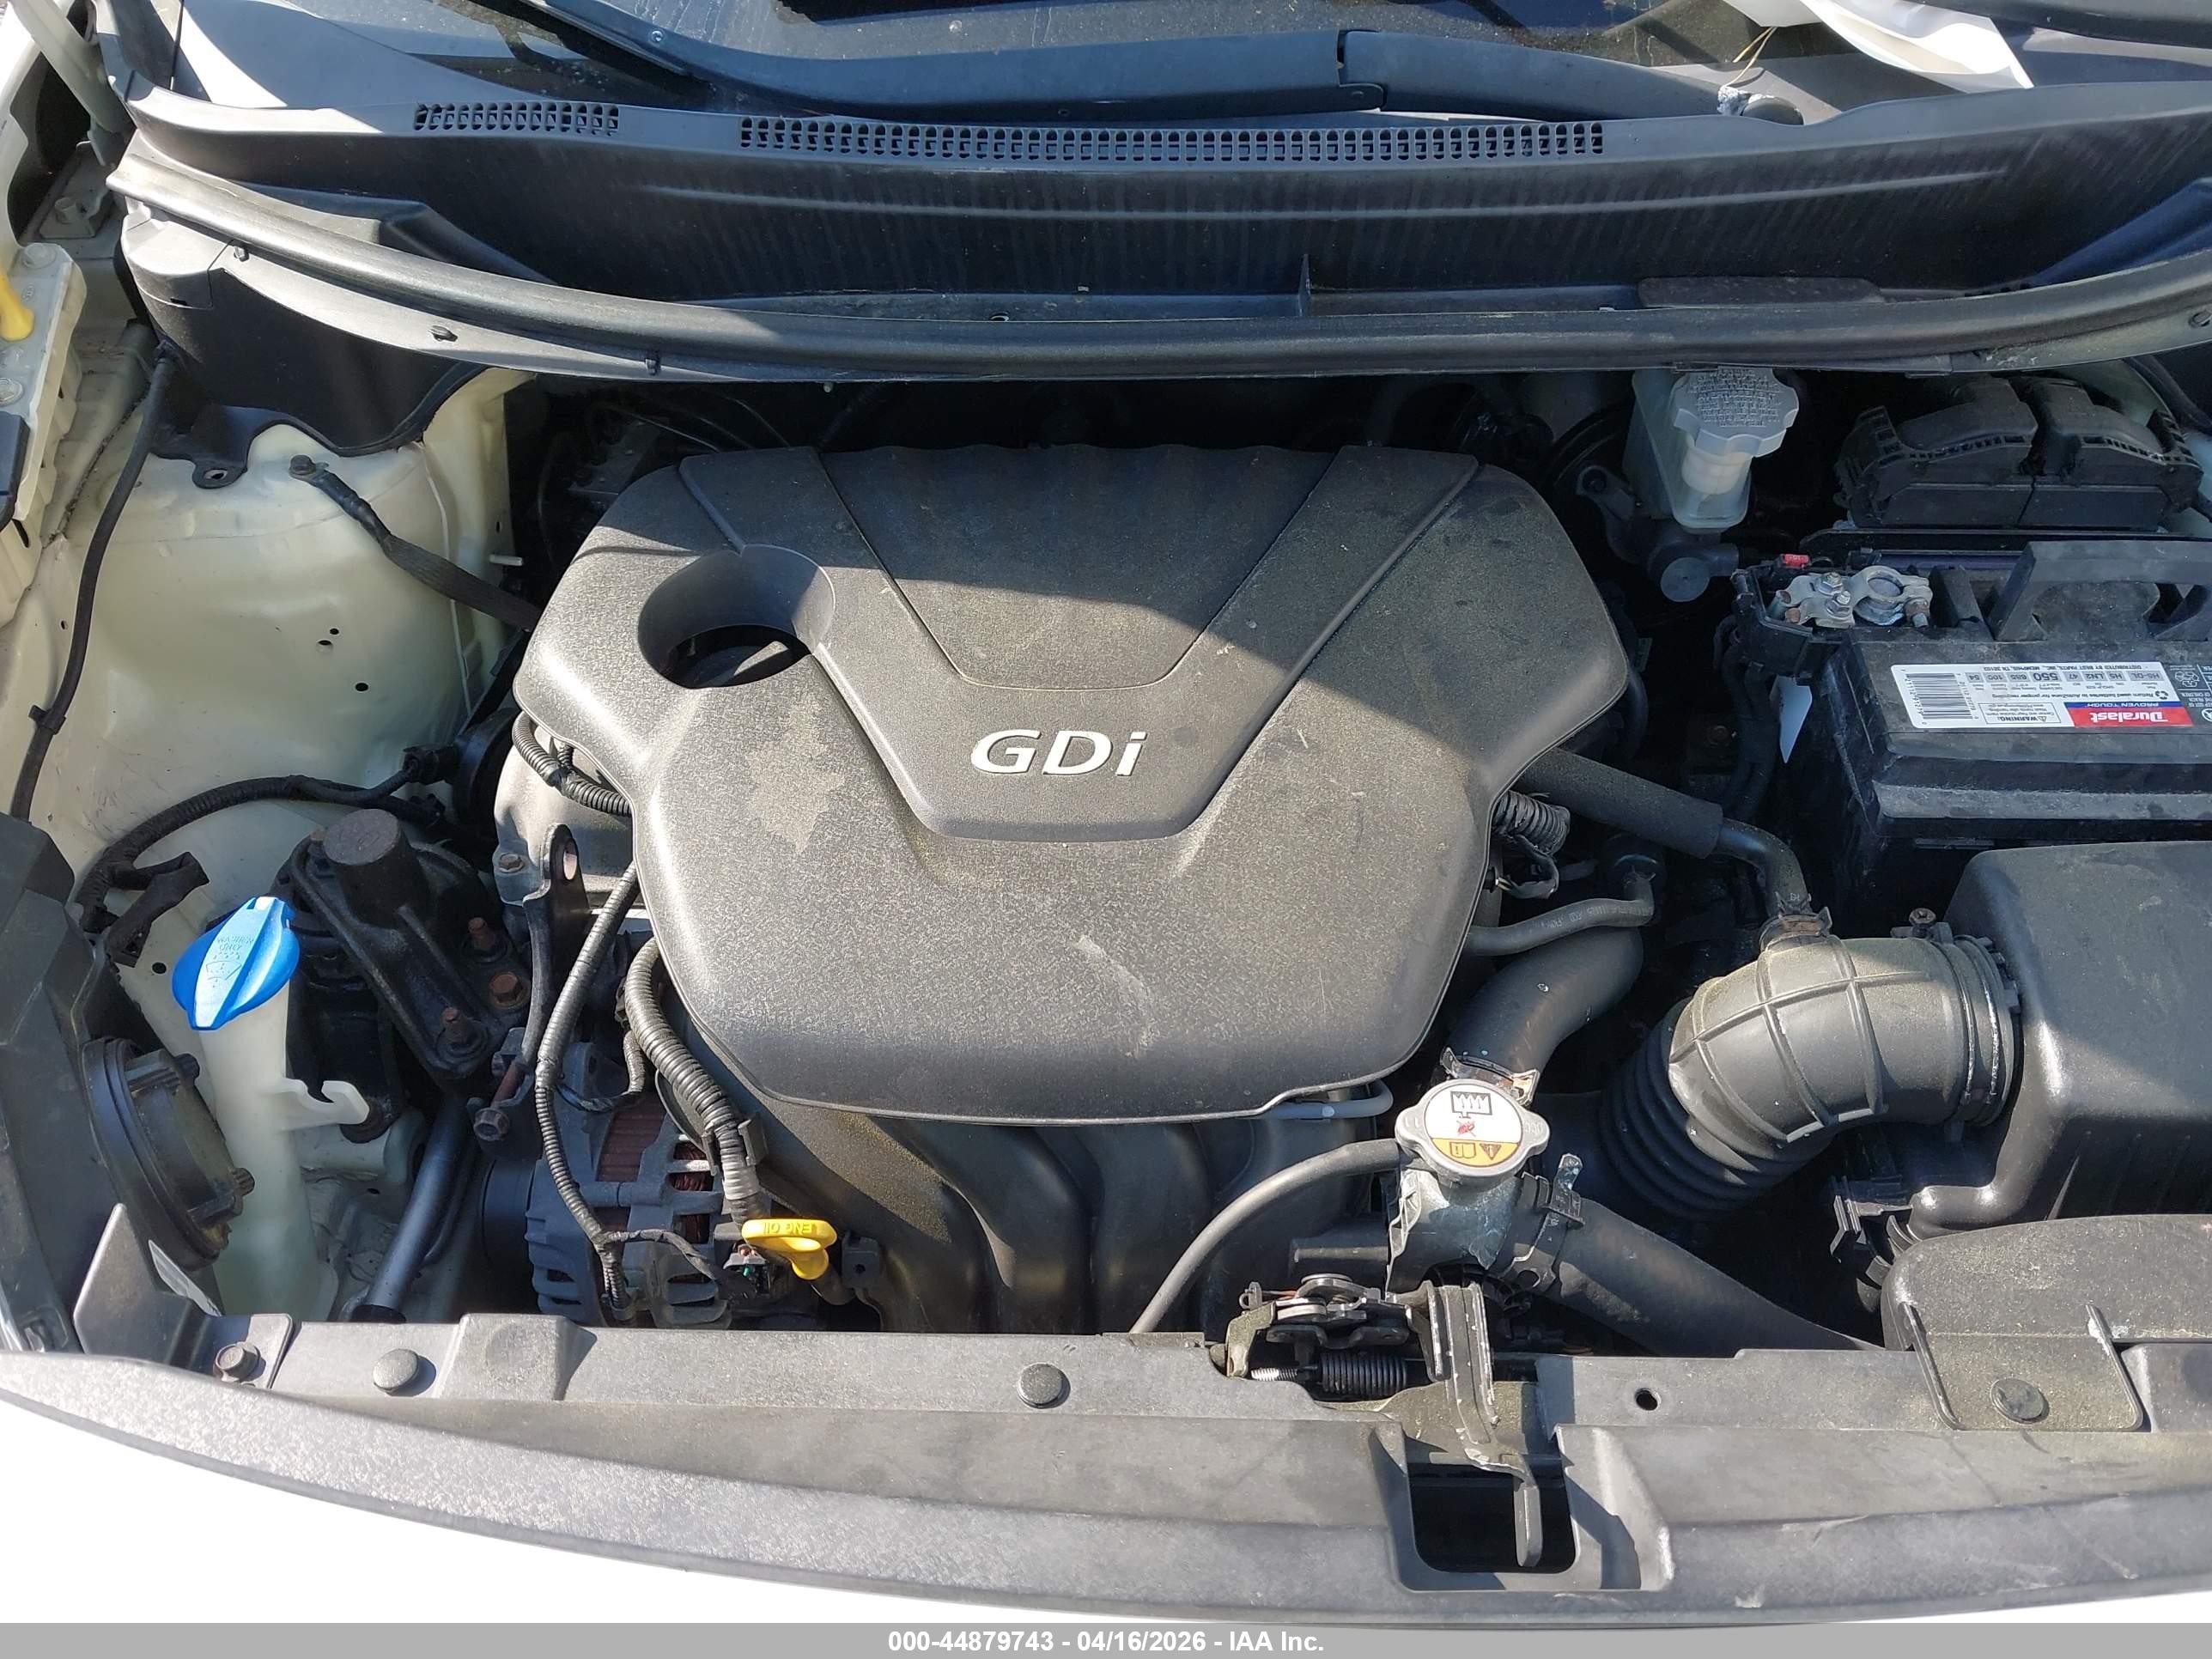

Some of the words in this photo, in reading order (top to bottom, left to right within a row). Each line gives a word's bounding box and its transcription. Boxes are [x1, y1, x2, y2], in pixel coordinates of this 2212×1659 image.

[2033, 672, 2059, 681] 550
[2089, 712, 2169, 723] Duralast
[970, 729, 1147, 776] GDi
